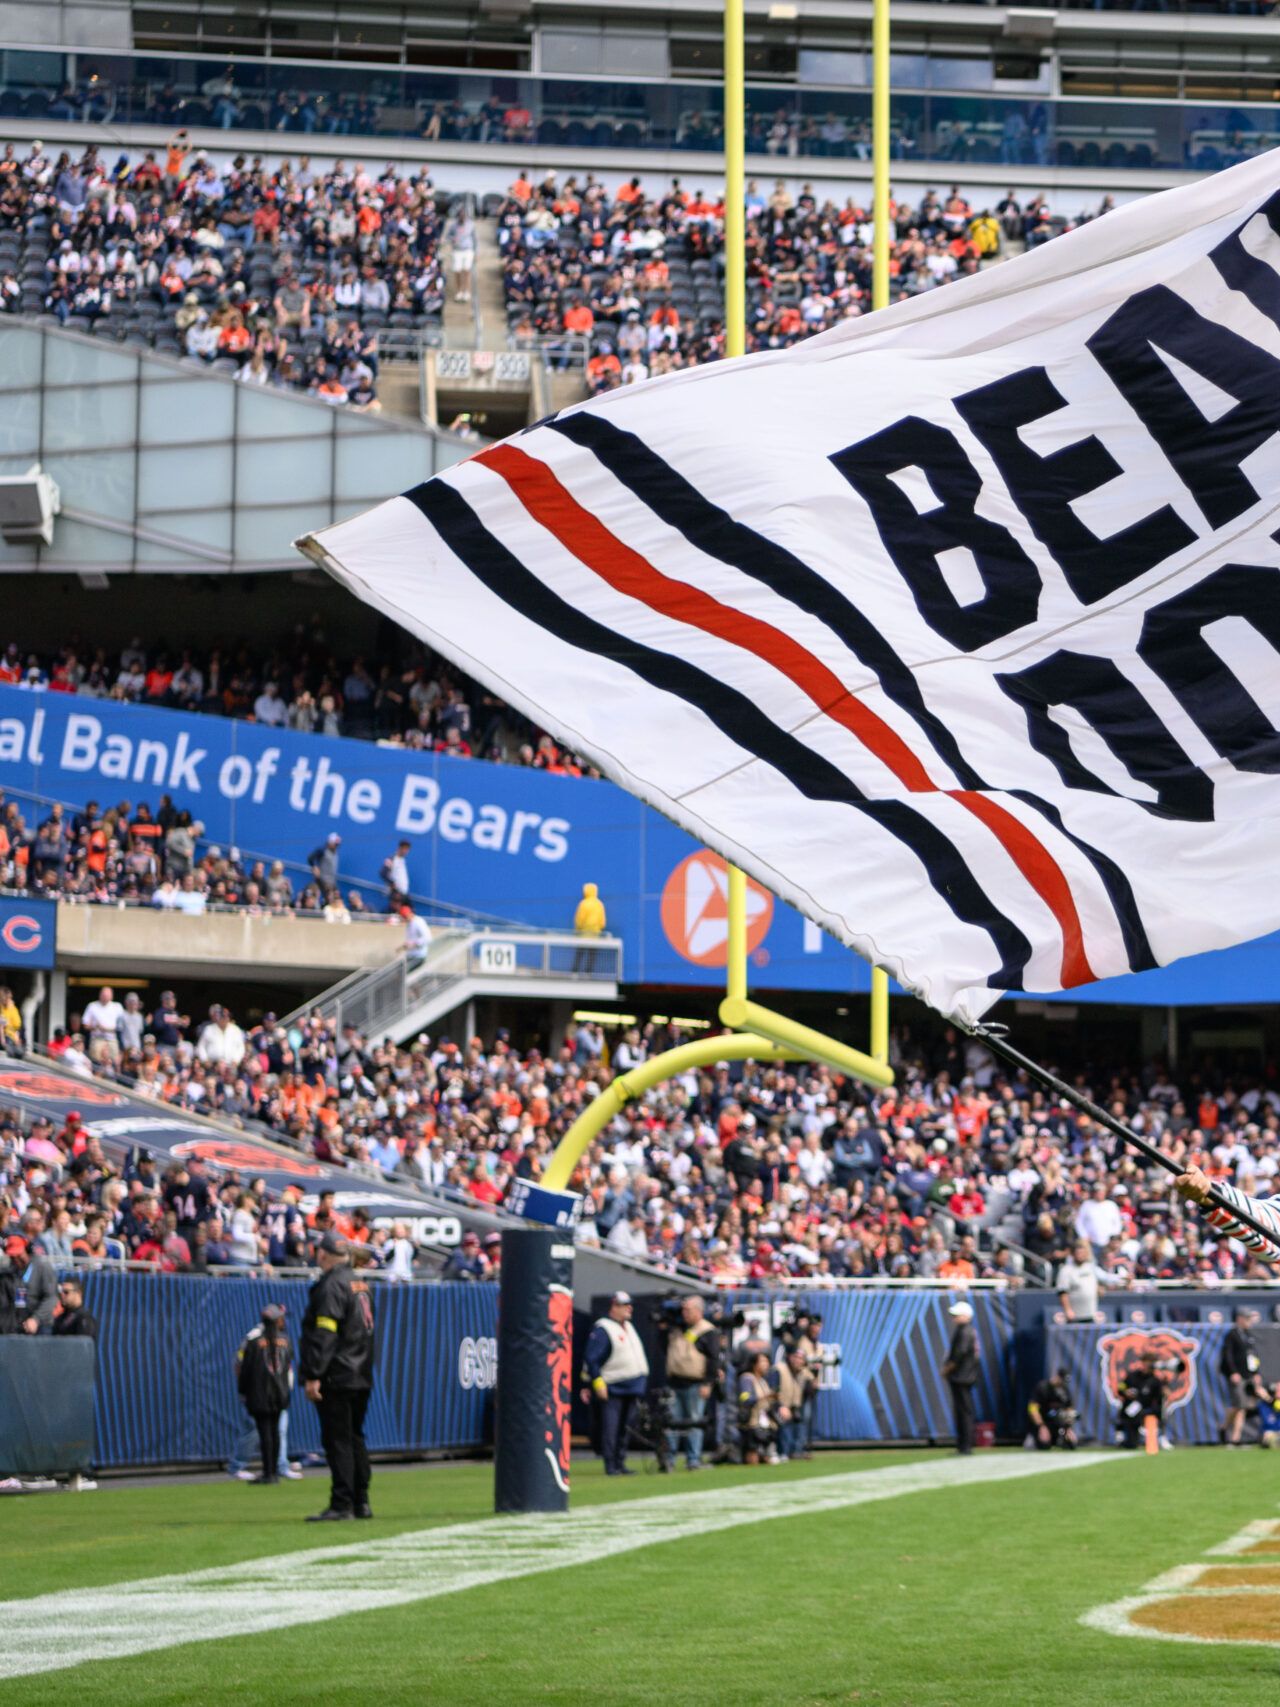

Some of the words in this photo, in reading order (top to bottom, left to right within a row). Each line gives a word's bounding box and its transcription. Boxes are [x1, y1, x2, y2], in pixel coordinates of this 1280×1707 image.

[439, 351, 467, 376] 302
[0, 708, 46, 767] al
[60, 712, 208, 792] Bank
[218, 747, 281, 804] of
[289, 756, 382, 824] the
[395, 773, 571, 863] Bears
[486, 946, 512, 966] 101
